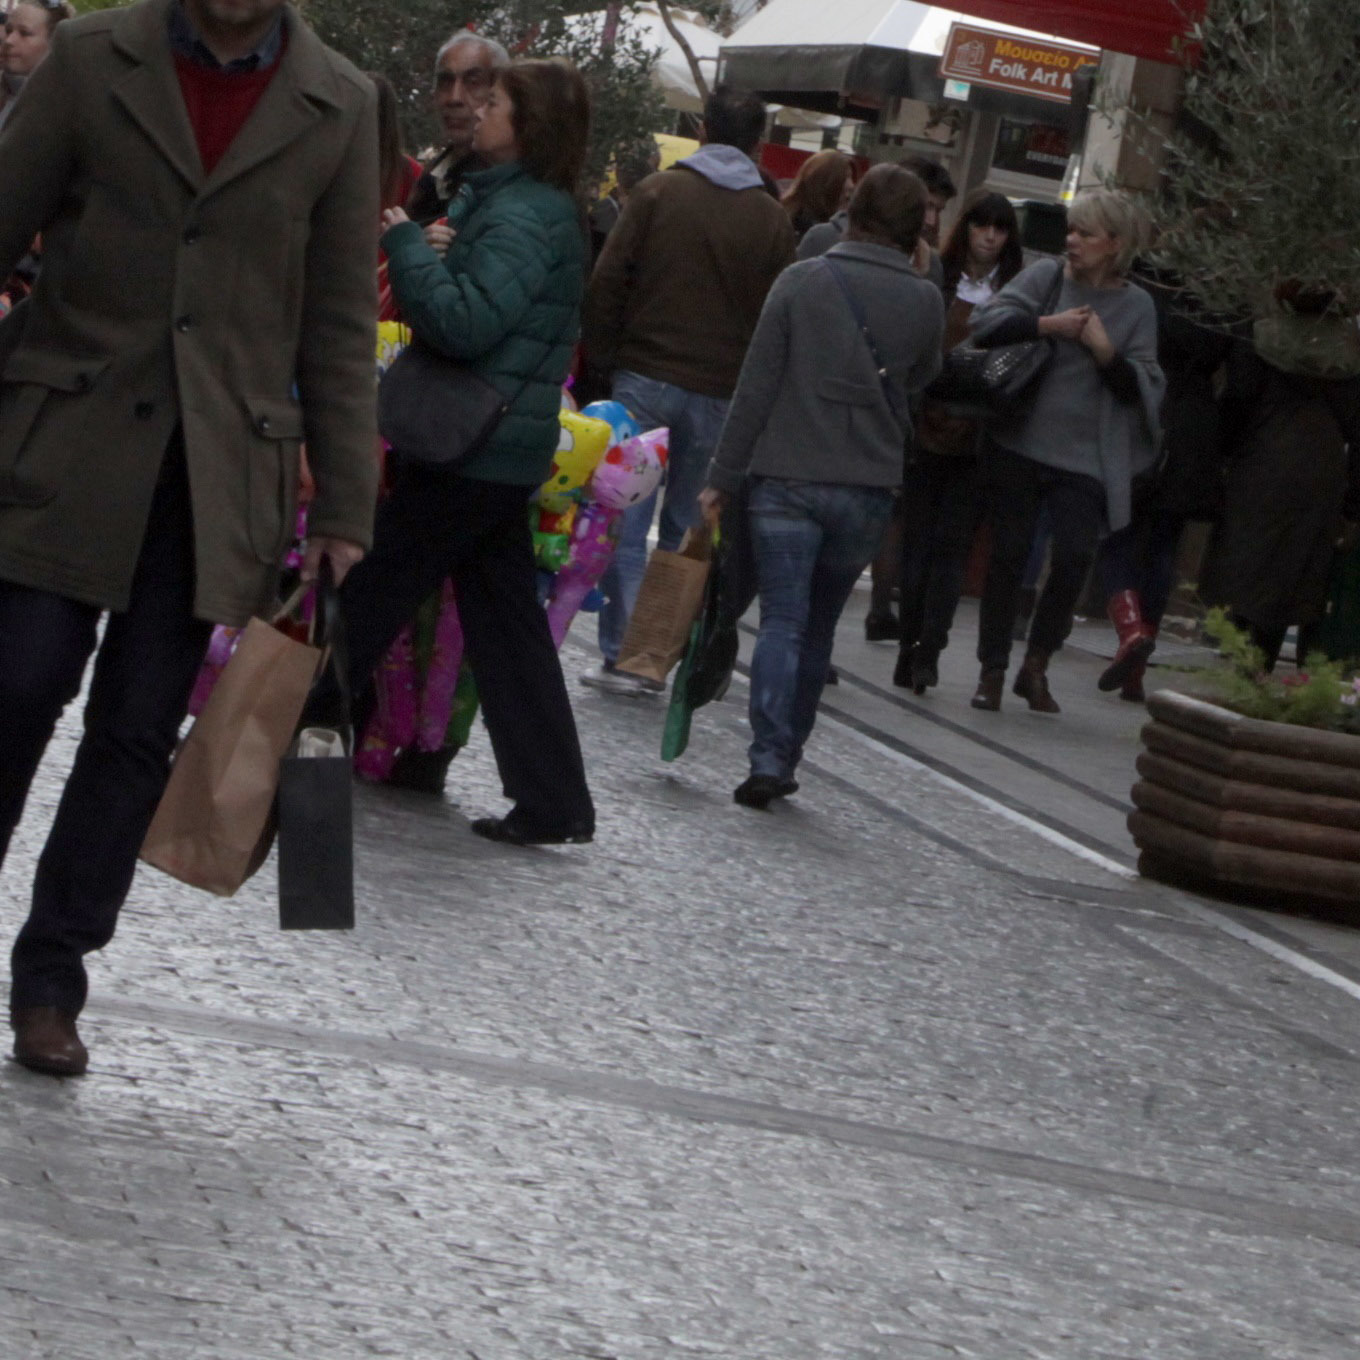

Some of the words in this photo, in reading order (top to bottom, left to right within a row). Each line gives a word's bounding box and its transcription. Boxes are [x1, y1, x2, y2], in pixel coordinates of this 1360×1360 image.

[995, 40, 1070, 69] Μουσείο
[988, 58, 1027, 81] Folk
[1030, 66, 1058, 87] Art
